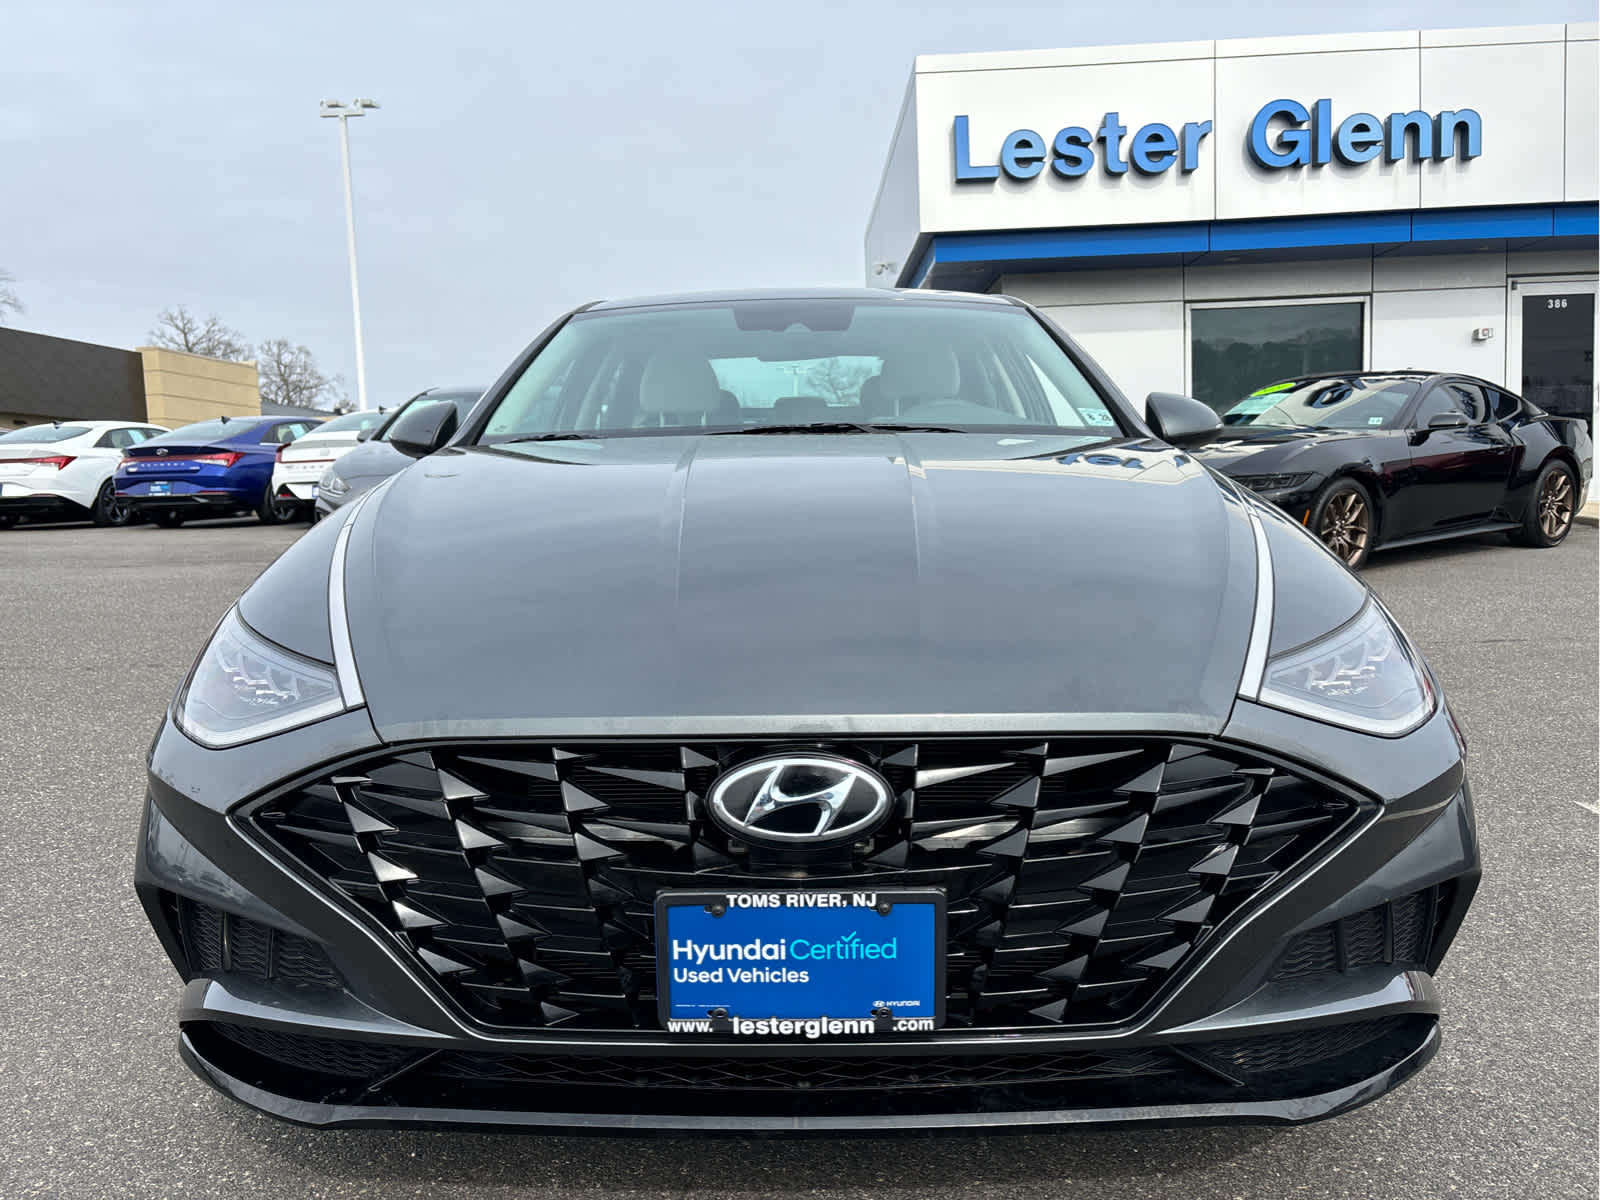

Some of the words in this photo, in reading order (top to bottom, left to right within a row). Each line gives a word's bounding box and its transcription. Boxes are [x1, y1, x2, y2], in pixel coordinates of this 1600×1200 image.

[953, 111, 1213, 182] Lester
[1249, 98, 1483, 169] Glenn
[1547, 298, 1568, 309] 386
[726, 893, 781, 908] TOMS
[786, 893, 848, 908] RIVER,
[852, 892, 877, 907] NJ
[672, 938, 787, 965] Hyundai
[789, 930, 897, 960] Certified
[673, 967, 723, 983] Used
[727, 967, 810, 983] Vehicles
[732, 1015, 875, 1039] lesterglenn
